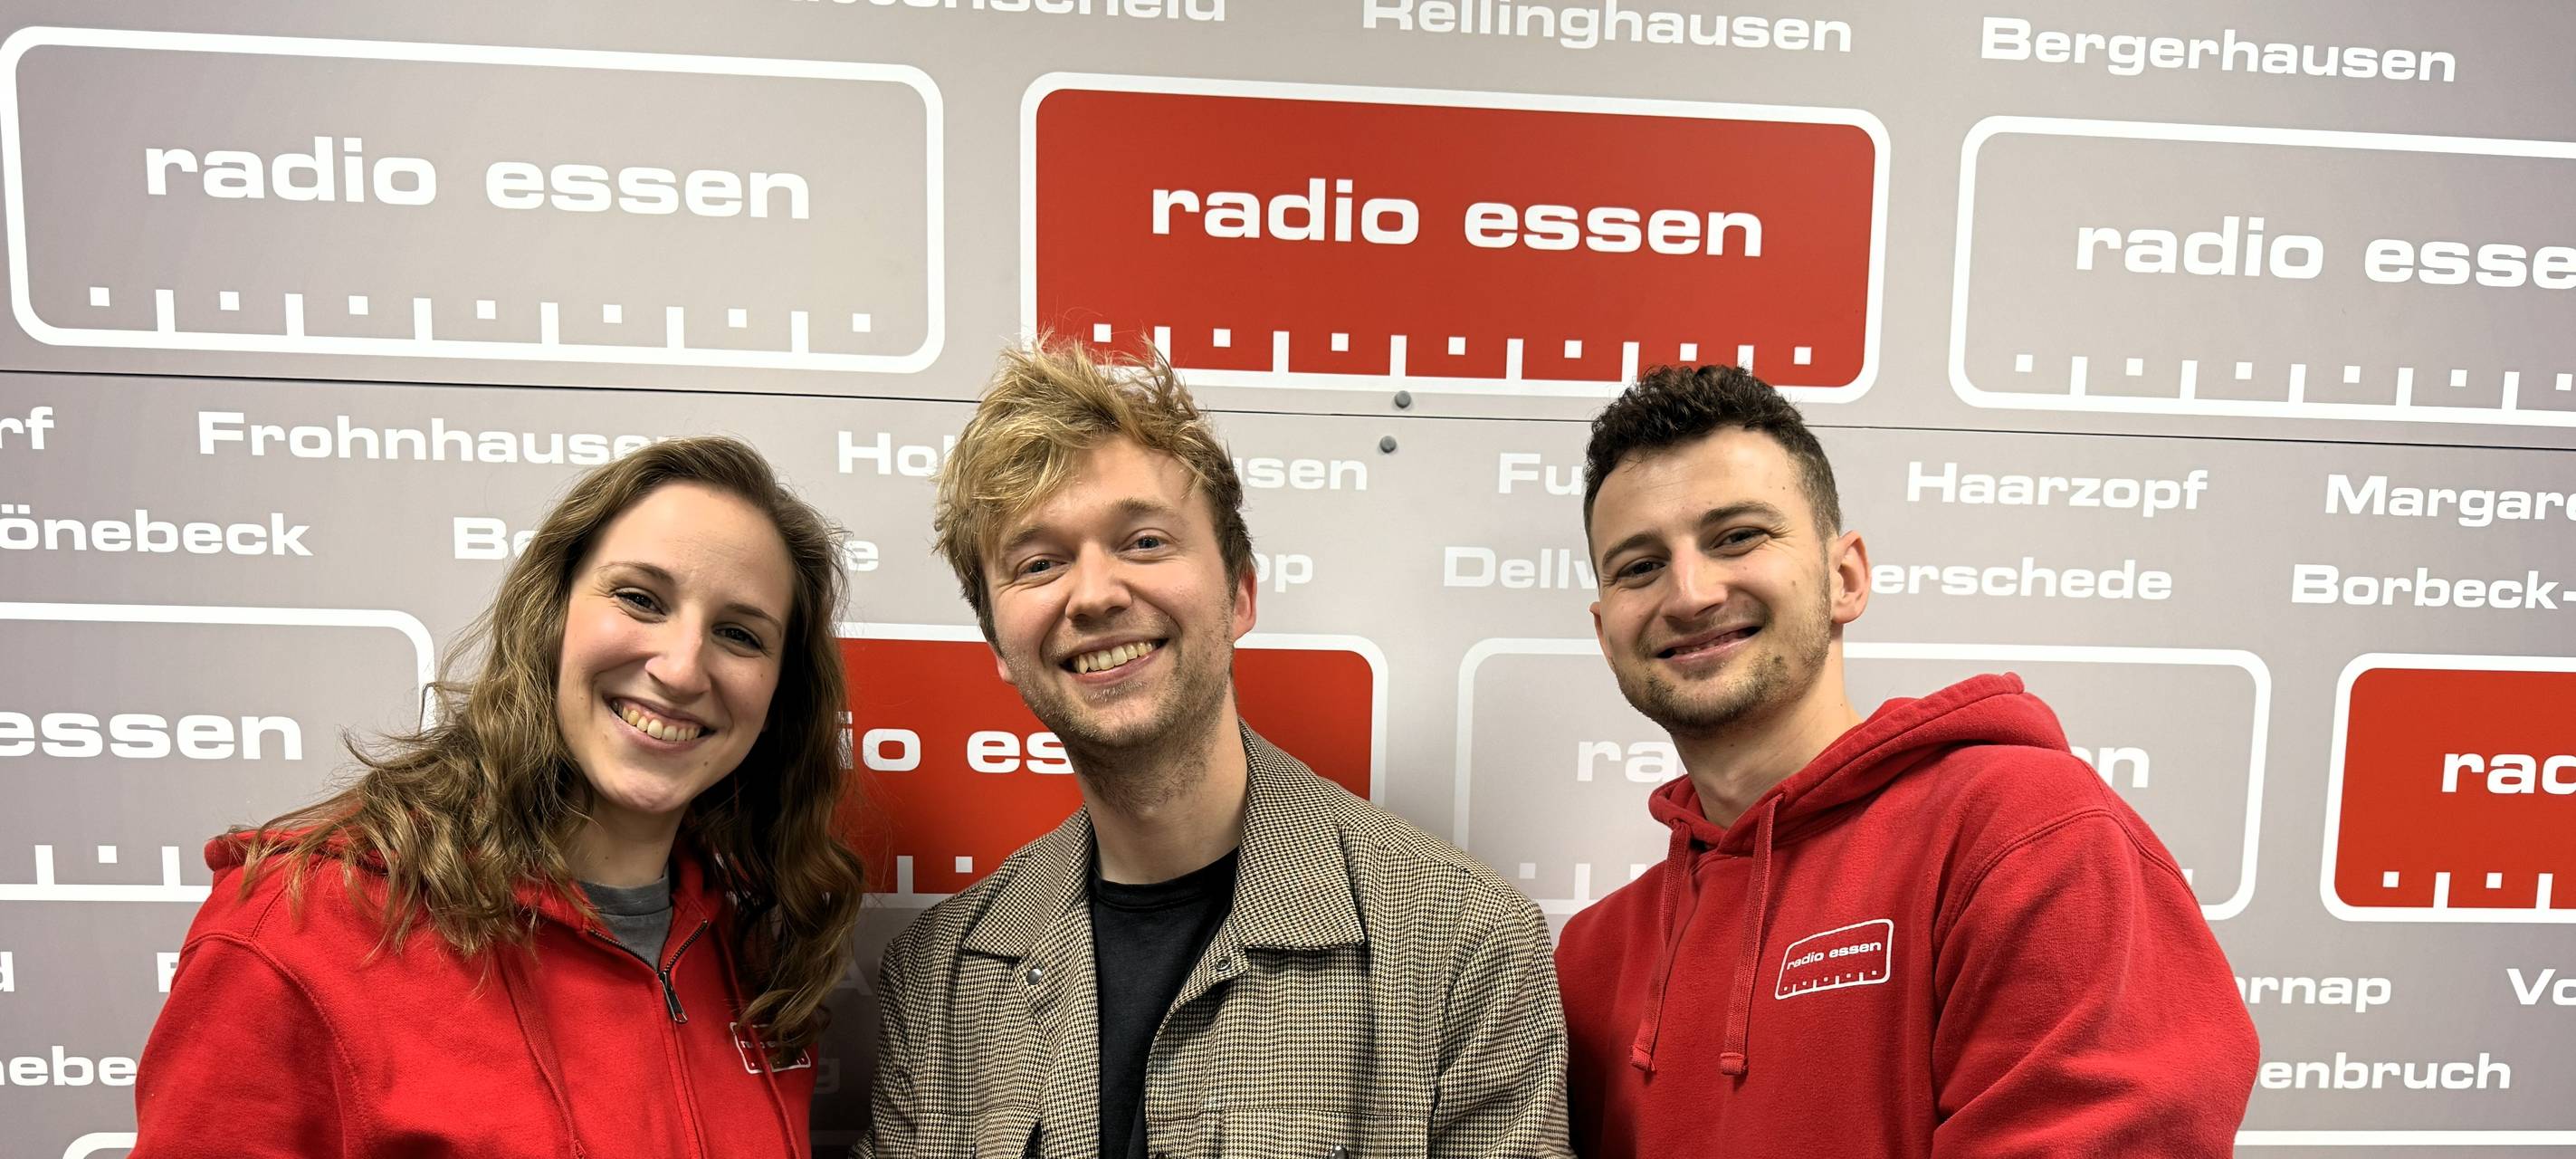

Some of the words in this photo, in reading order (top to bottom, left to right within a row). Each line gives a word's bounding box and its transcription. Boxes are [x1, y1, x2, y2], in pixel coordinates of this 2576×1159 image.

[1363, 0, 1852, 53] Rellinghausen
[1980, 16, 2457, 82] Bergerhausen
[146, 136, 437, 206] radio
[485, 161, 810, 219] essen
[1152, 177, 1420, 244] radio
[1464, 202, 1762, 257] essen
[2076, 216, 2324, 279] radio
[198, 411, 670, 465] Frohnhause
[1906, 461, 2209, 518] Haarzopf
[2324, 474, 2576, 527] Margar
[1871, 556, 2172, 600] erschede
[1787, 952, 1825, 970] radio
[1828, 942, 1883, 959] essen
[2260, 1052, 2512, 1089] enbruch
